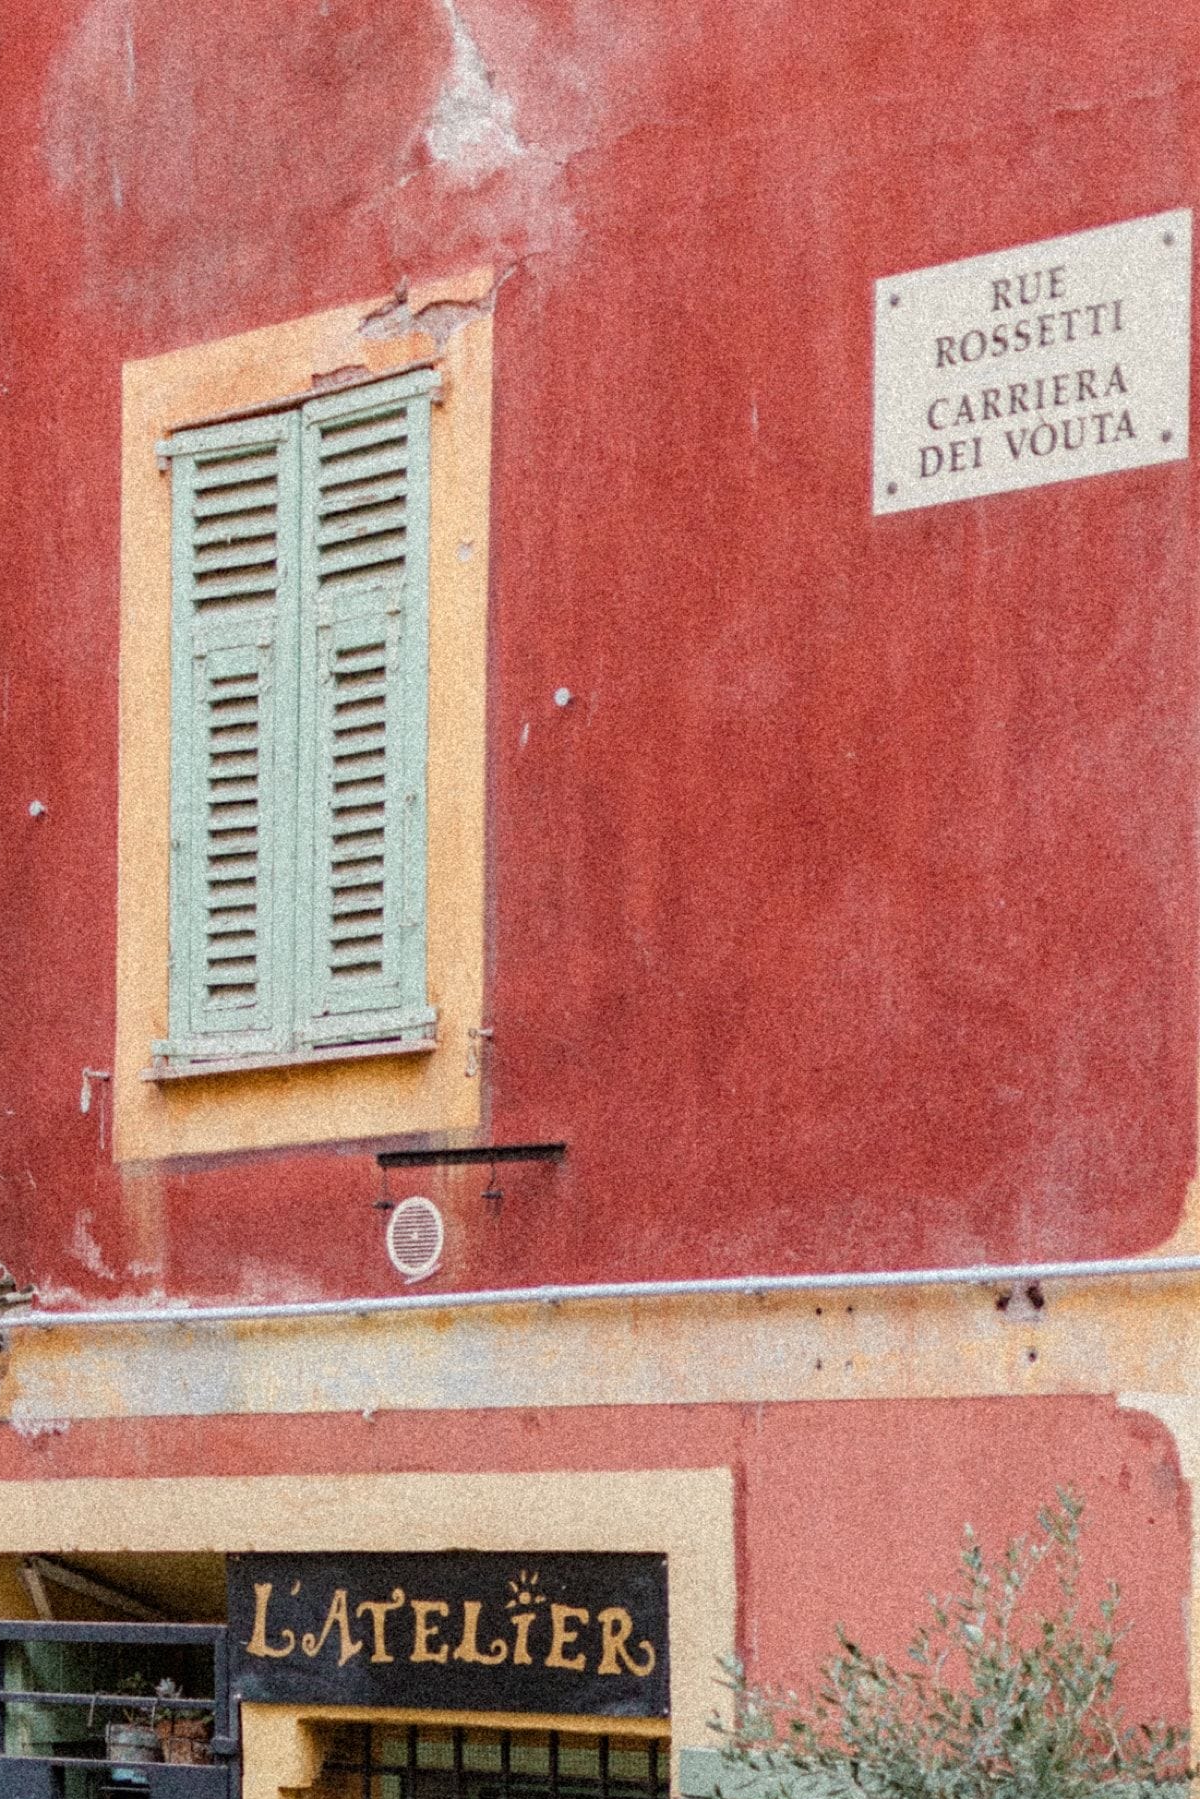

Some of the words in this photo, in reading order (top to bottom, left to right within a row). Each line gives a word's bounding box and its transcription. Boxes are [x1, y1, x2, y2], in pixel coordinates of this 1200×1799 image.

[989, 265, 1067, 312] RUE
[934, 300, 1124, 368] ROSSETTI
[926, 365, 1129, 430] CARRIERA
[918, 437, 984, 478] DEI
